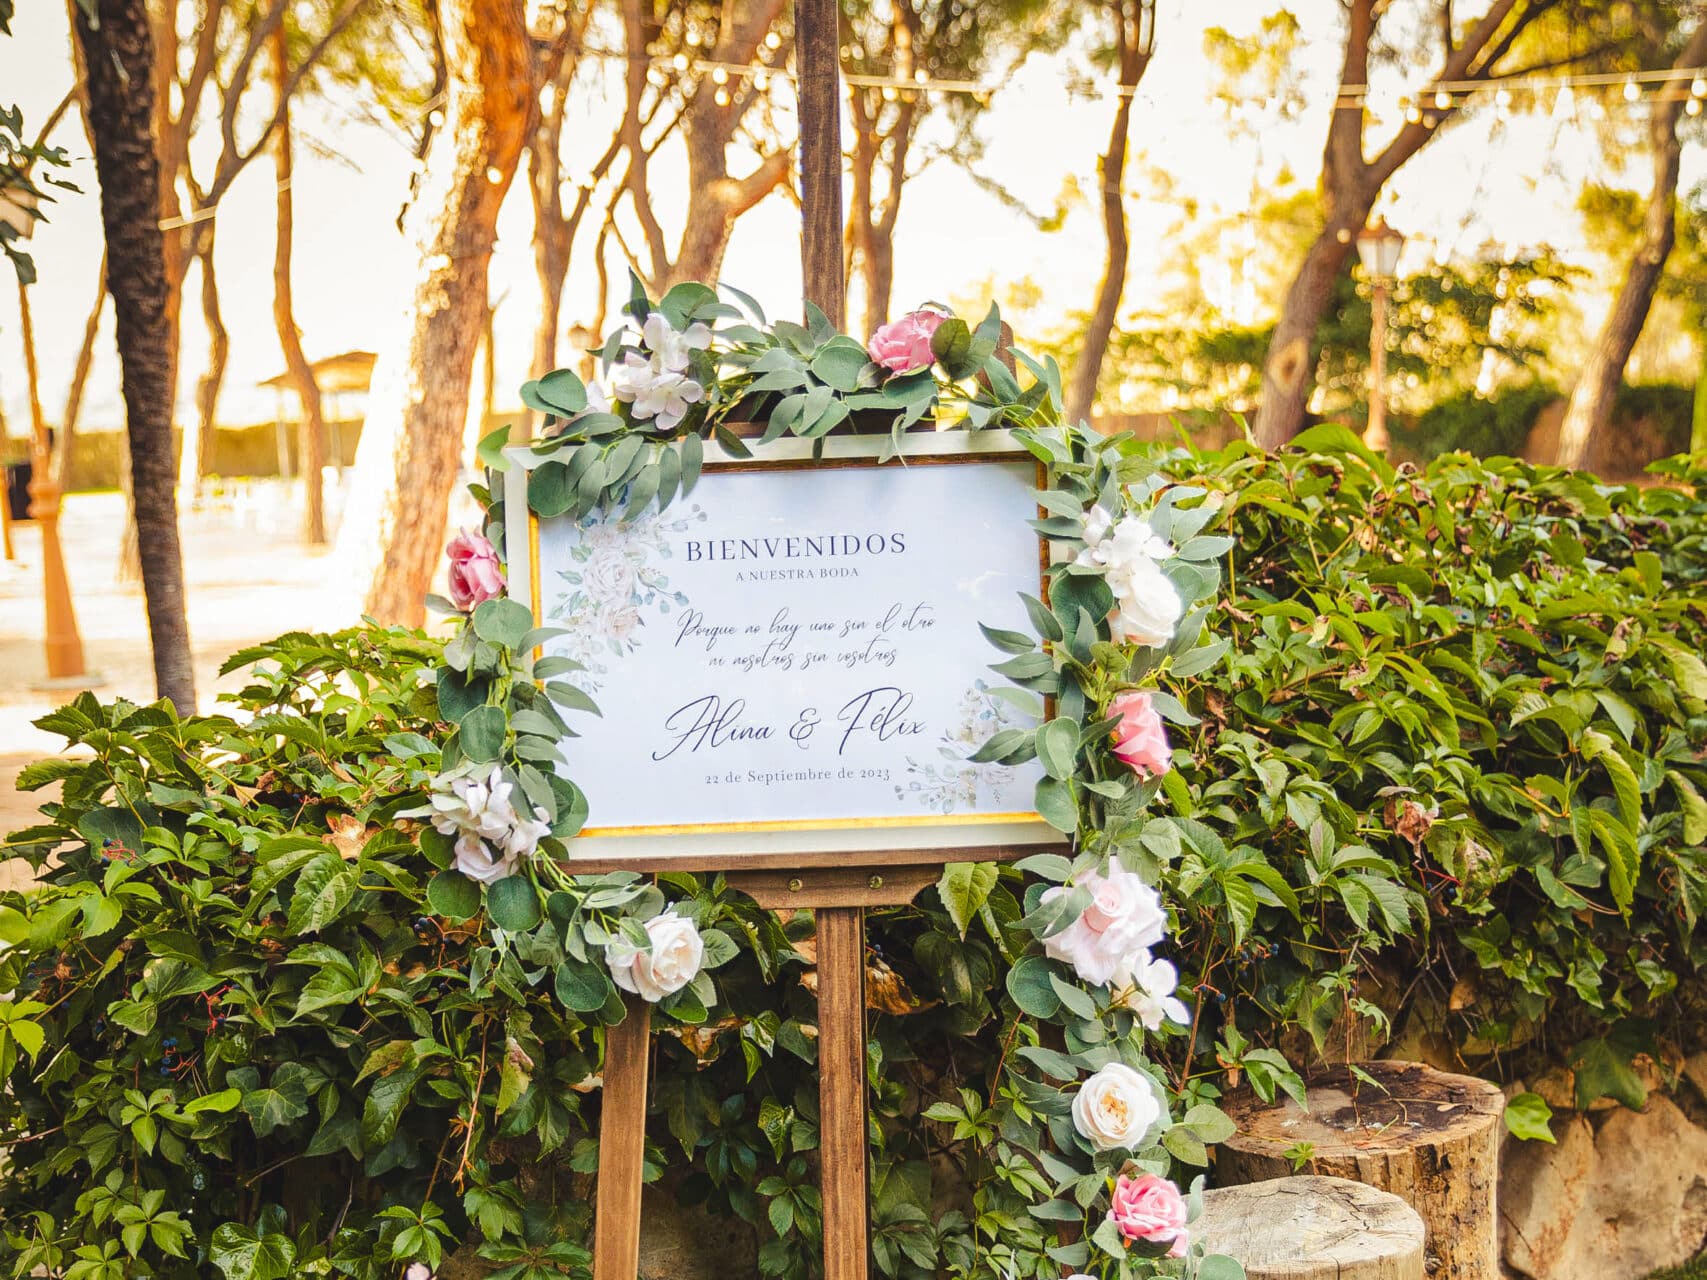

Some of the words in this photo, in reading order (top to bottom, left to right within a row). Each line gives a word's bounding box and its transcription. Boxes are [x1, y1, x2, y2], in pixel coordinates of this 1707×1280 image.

[686, 533, 906, 561] BIENVENIDOS
[736, 572, 744, 582] A
[749, 569, 814, 581] NUESTRA
[820, 567, 859, 578] BODA
[674, 608, 737, 651] Porque
[745, 624, 761, 635] no
[769, 607, 800, 650] hay
[810, 620, 835, 632] uno
[839, 618, 867, 638] sin
[875, 602, 902, 632] el
[902, 601, 936, 631] otro
[709, 654, 724, 667] ni
[733, 639, 793, 672] nosotros
[800, 651, 828, 672] sin
[837, 634, 897, 668] vosotros
[652, 695, 776, 761] Alina
[789, 707, 821, 750] &
[837, 686, 926, 755] Félix
[705, 775, 719, 784] 22
[725, 771, 742, 783] de
[748, 768, 832, 786] Septiembre
[837, 767, 854, 779] de
[860, 768, 890, 781] 2023
